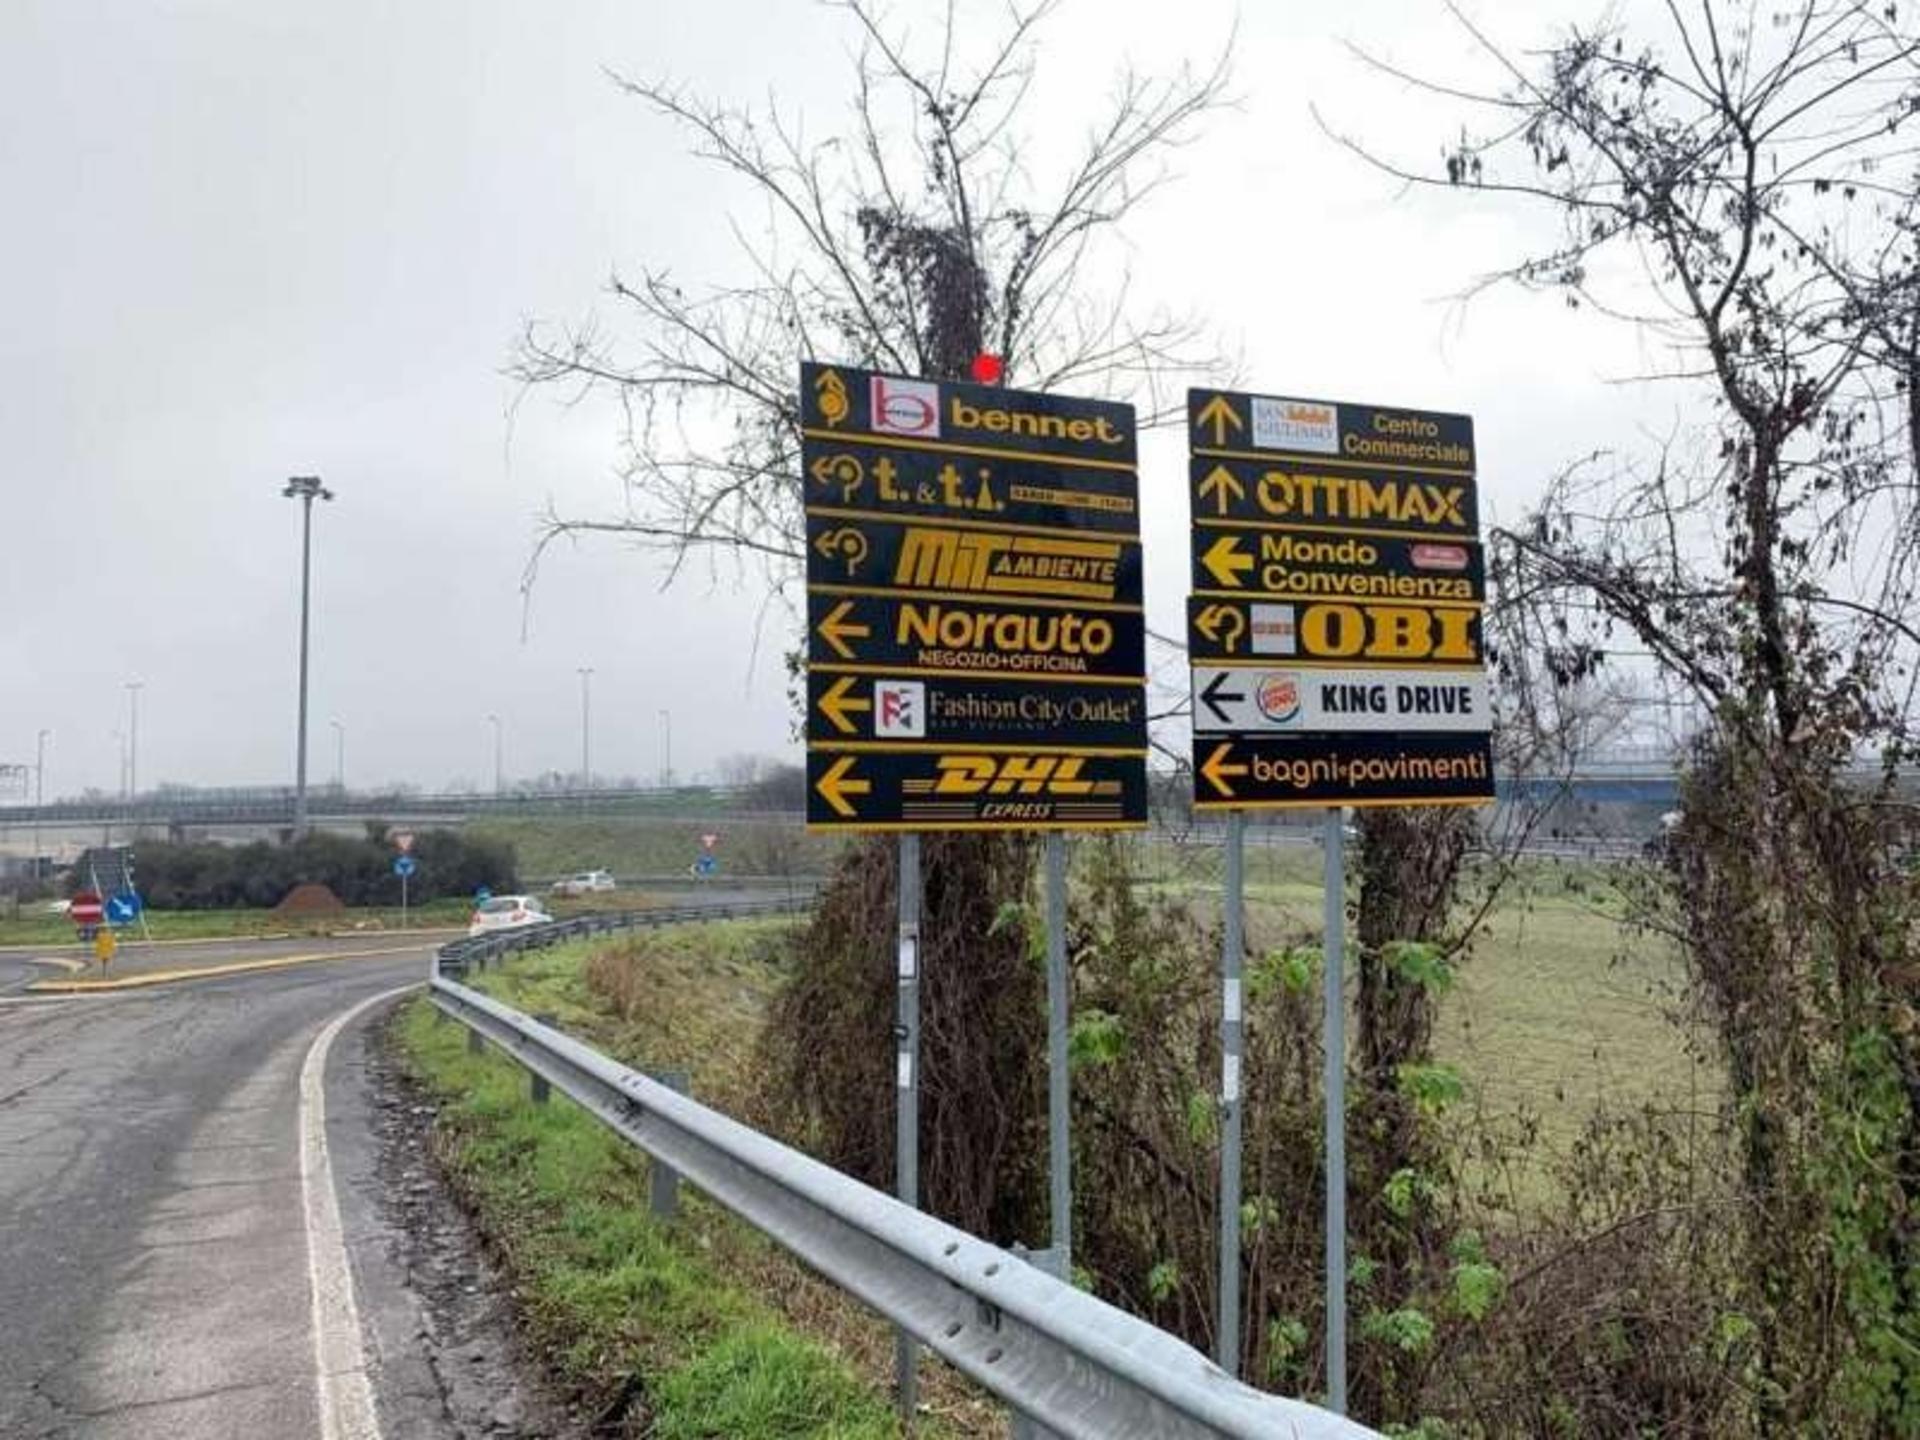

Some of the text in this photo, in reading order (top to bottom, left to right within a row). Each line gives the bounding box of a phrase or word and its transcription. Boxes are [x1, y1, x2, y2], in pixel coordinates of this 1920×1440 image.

[951, 397, 1125, 444] bennet
[1373, 413, 1438, 437] Centro
[1343, 433, 1470, 463] Commerciale
[1257, 471, 1467, 526] OTTIMAX
[1262, 536, 1378, 566] Mondo
[993, 552, 1117, 582] AMBIENTE
[1262, 566, 1473, 598] Convenienza
[896, 603, 1114, 655] Norauto
[1301, 603, 1477, 659] OBI
[917, 649, 1088, 673] NEGOZIO+OFFICINA
[929, 690, 1016, 719] Fashion
[1018, 695, 1065, 726] City
[1321, 684, 1387, 713] KING
[1396, 685, 1473, 714] DRIVE
[935, 756, 1096, 794] DHL
[980, 802, 1054, 819] EXPRESS
